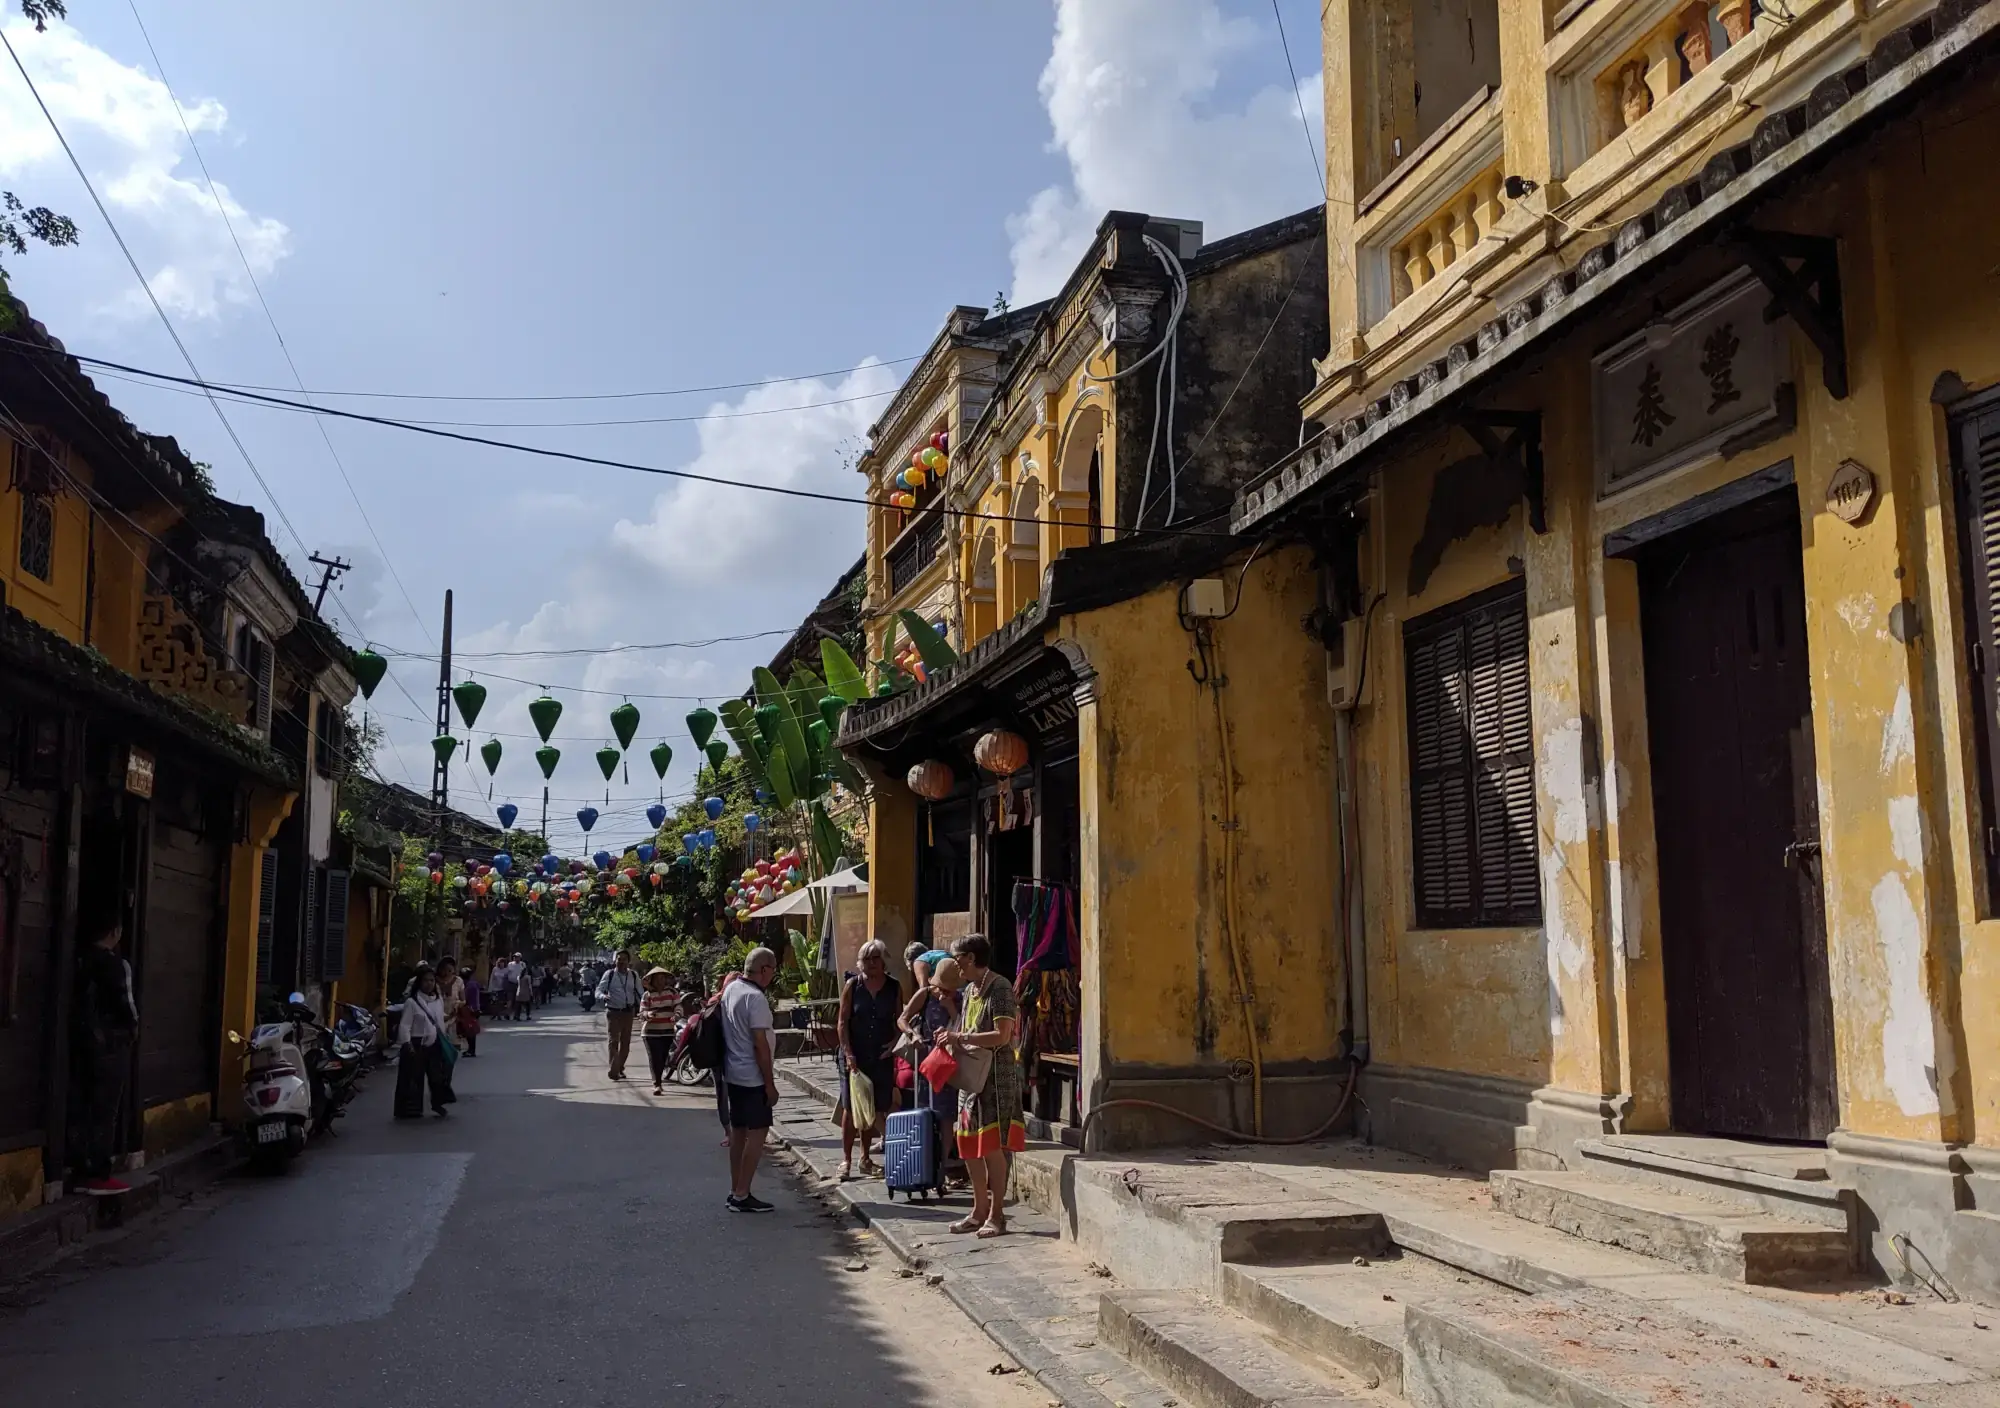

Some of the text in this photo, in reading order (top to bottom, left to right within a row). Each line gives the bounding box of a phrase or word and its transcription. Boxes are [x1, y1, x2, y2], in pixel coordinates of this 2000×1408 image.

[1834, 477, 1863, 507] 102
[1025, 683, 1070, 708] Souvenir Shop
